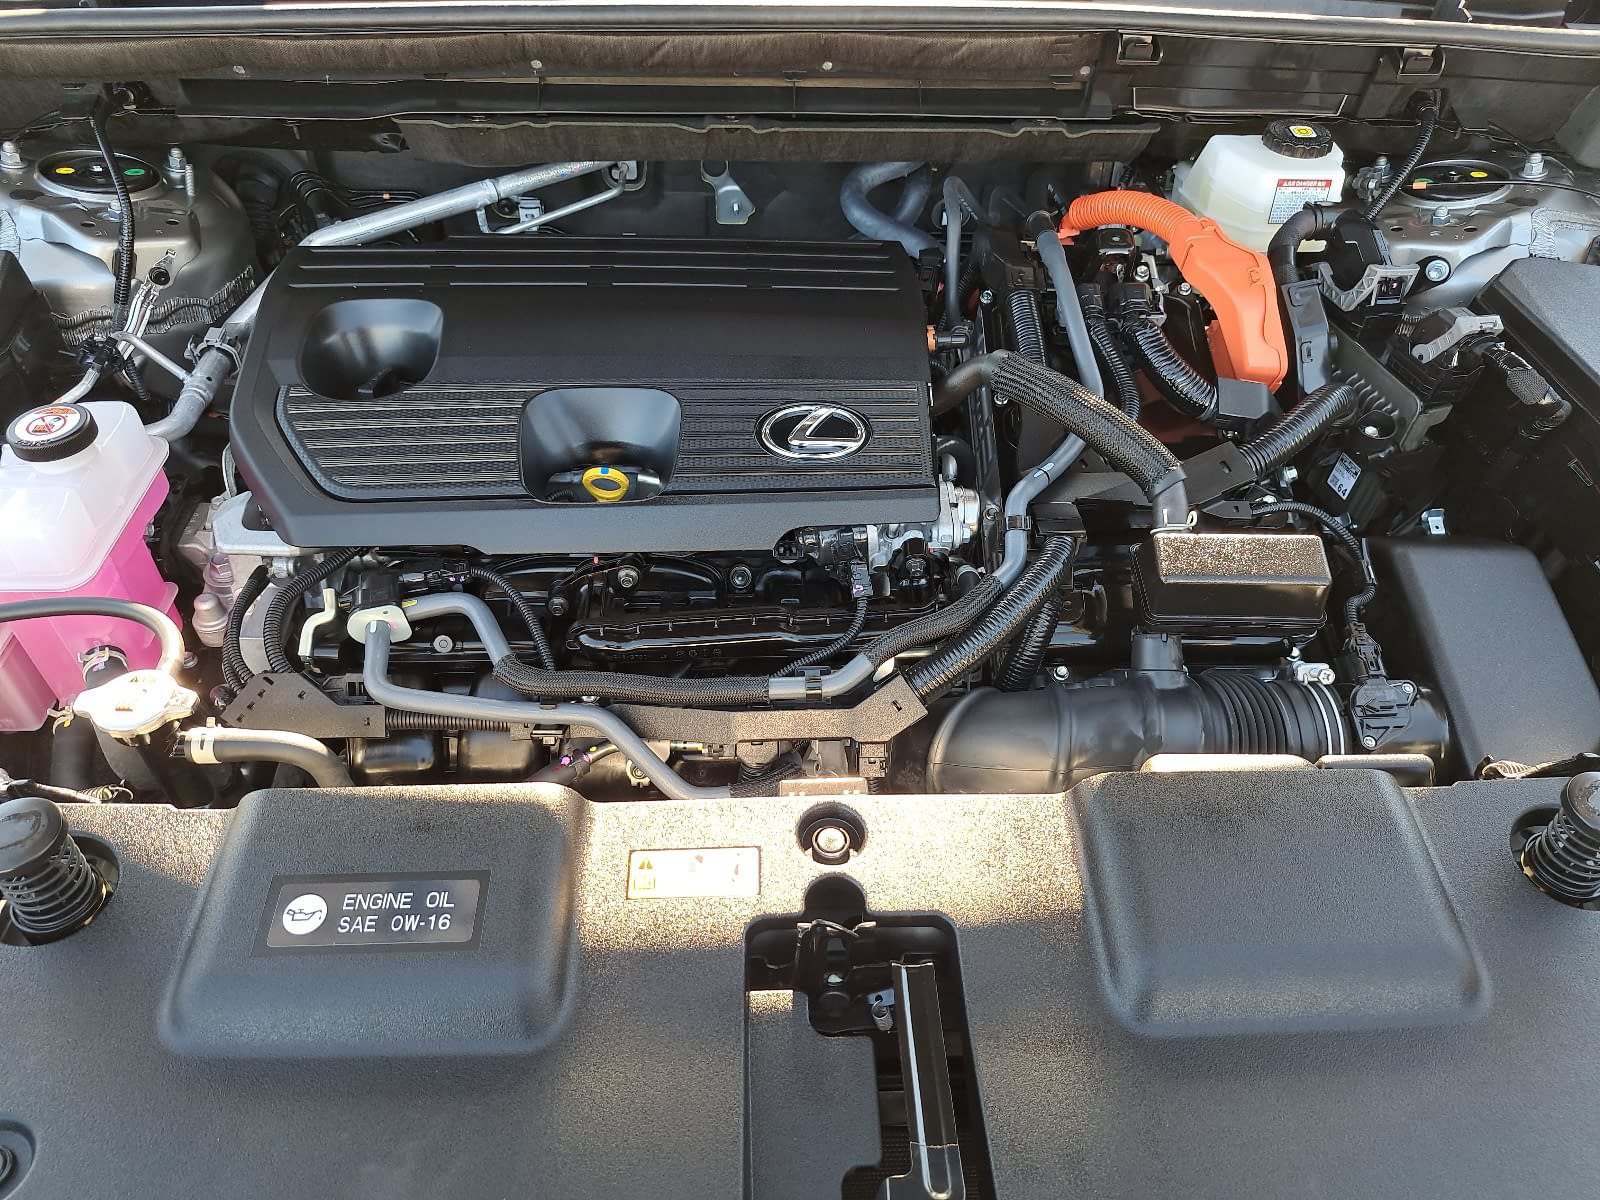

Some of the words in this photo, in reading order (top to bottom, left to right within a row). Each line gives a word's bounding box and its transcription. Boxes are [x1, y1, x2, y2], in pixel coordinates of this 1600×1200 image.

[1337, 484, 1347, 496] 64
[342, 892, 413, 910] ENGINE
[426, 891, 455, 908] OIL
[337, 915, 378, 933] SAE
